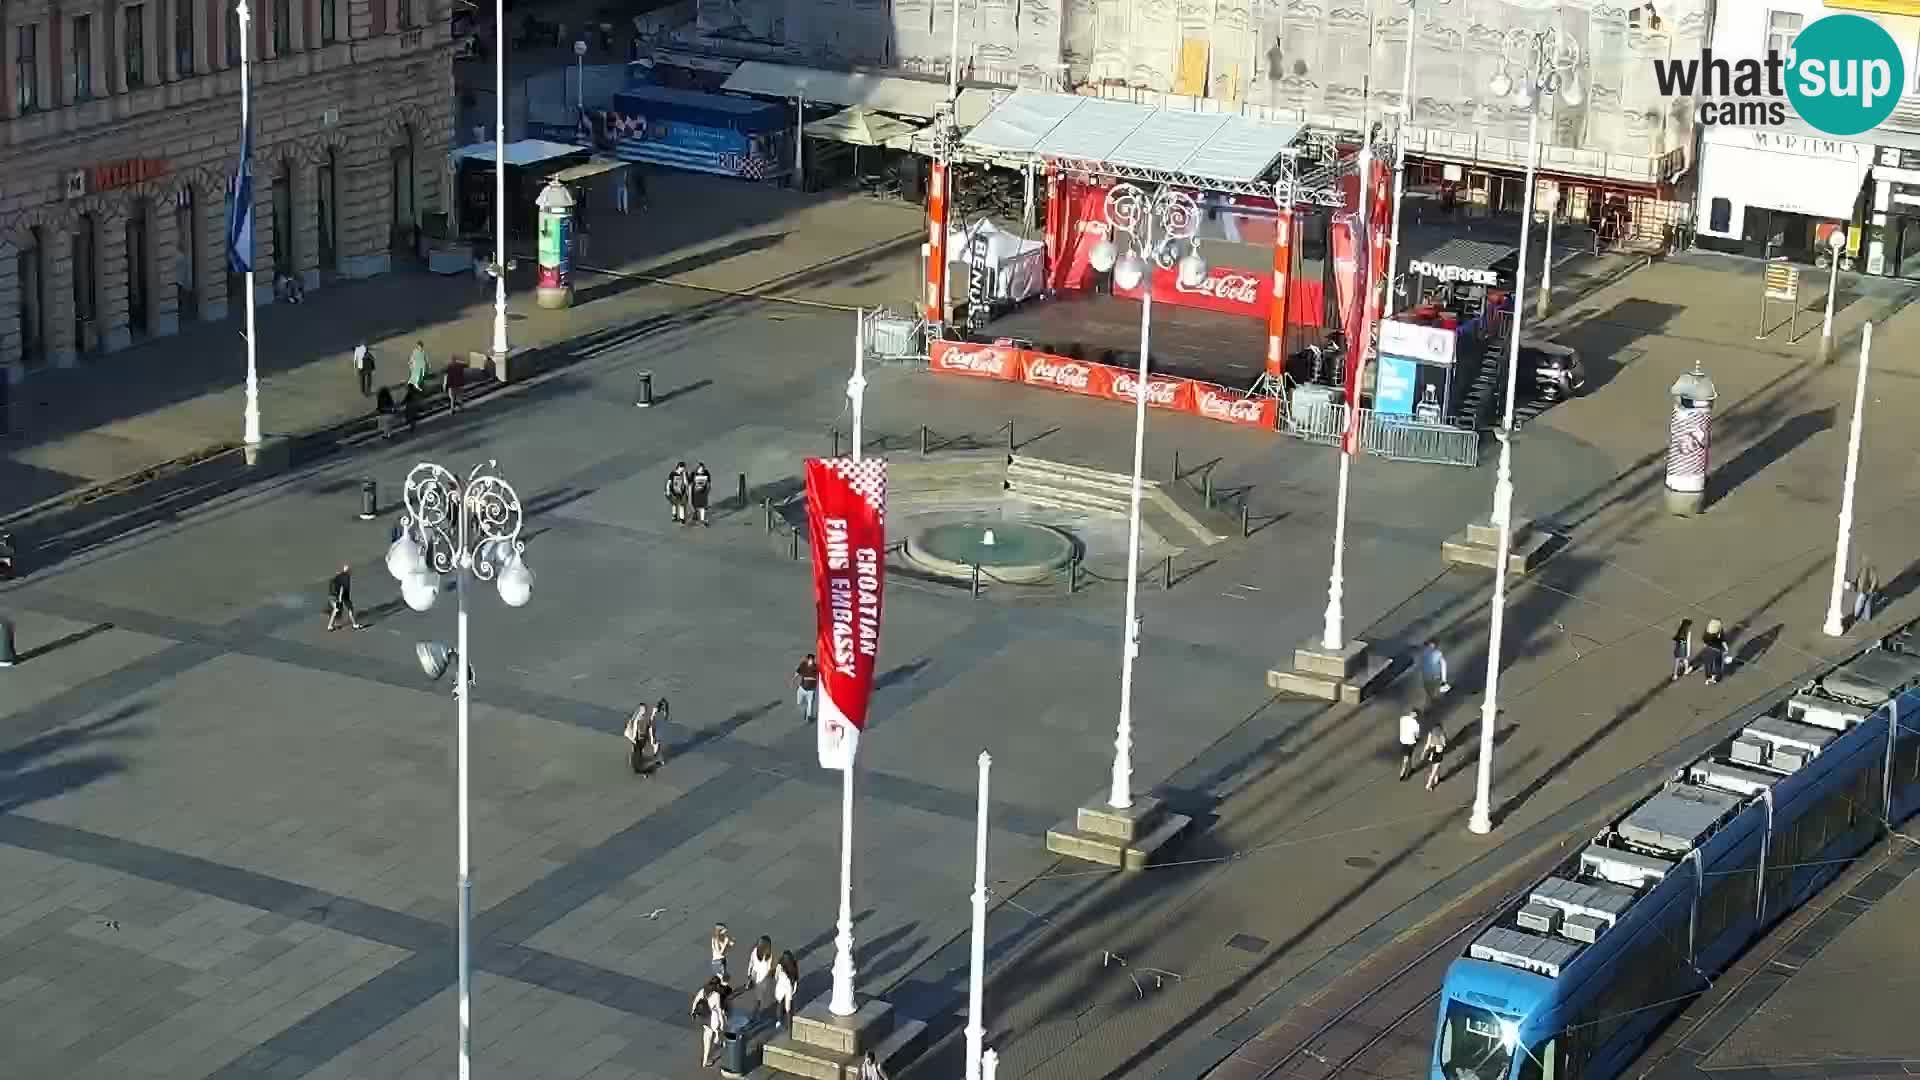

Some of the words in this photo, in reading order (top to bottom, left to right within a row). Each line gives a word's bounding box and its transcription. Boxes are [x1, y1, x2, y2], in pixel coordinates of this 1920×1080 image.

[1409, 259, 1498, 286] POWERADE
[824, 517, 849, 569] FANS
[831, 577, 856, 678] EMBASSY
[855, 547, 881, 656] CROATIAN
